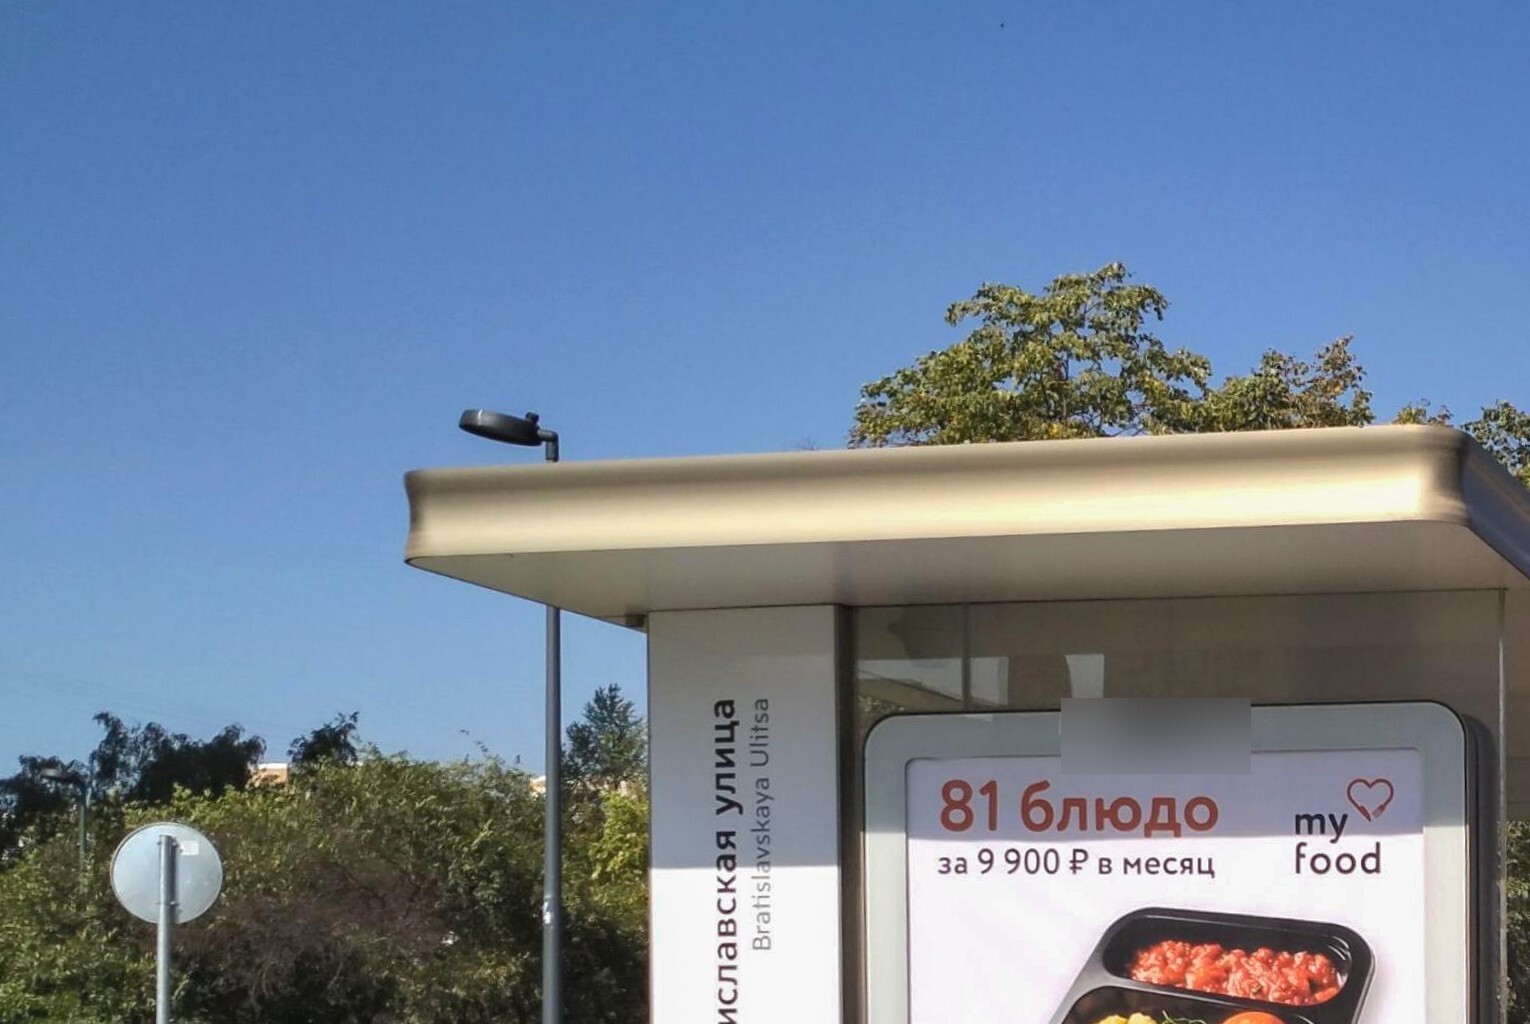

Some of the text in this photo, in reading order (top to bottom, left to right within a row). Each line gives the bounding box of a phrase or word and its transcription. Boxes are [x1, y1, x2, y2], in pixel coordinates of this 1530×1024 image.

[713, 698, 743, 816] улица
[750, 697, 773, 951] Bratislavskaya Ulitsa
[939, 779, 1219, 838] 81 блюдо
[1295, 809, 1348, 843] my
[937, 853, 967, 875] за
[1098, 855, 1112, 875] в
[1123, 853, 1216, 879] месяц
[1295, 842, 1382, 875] food
